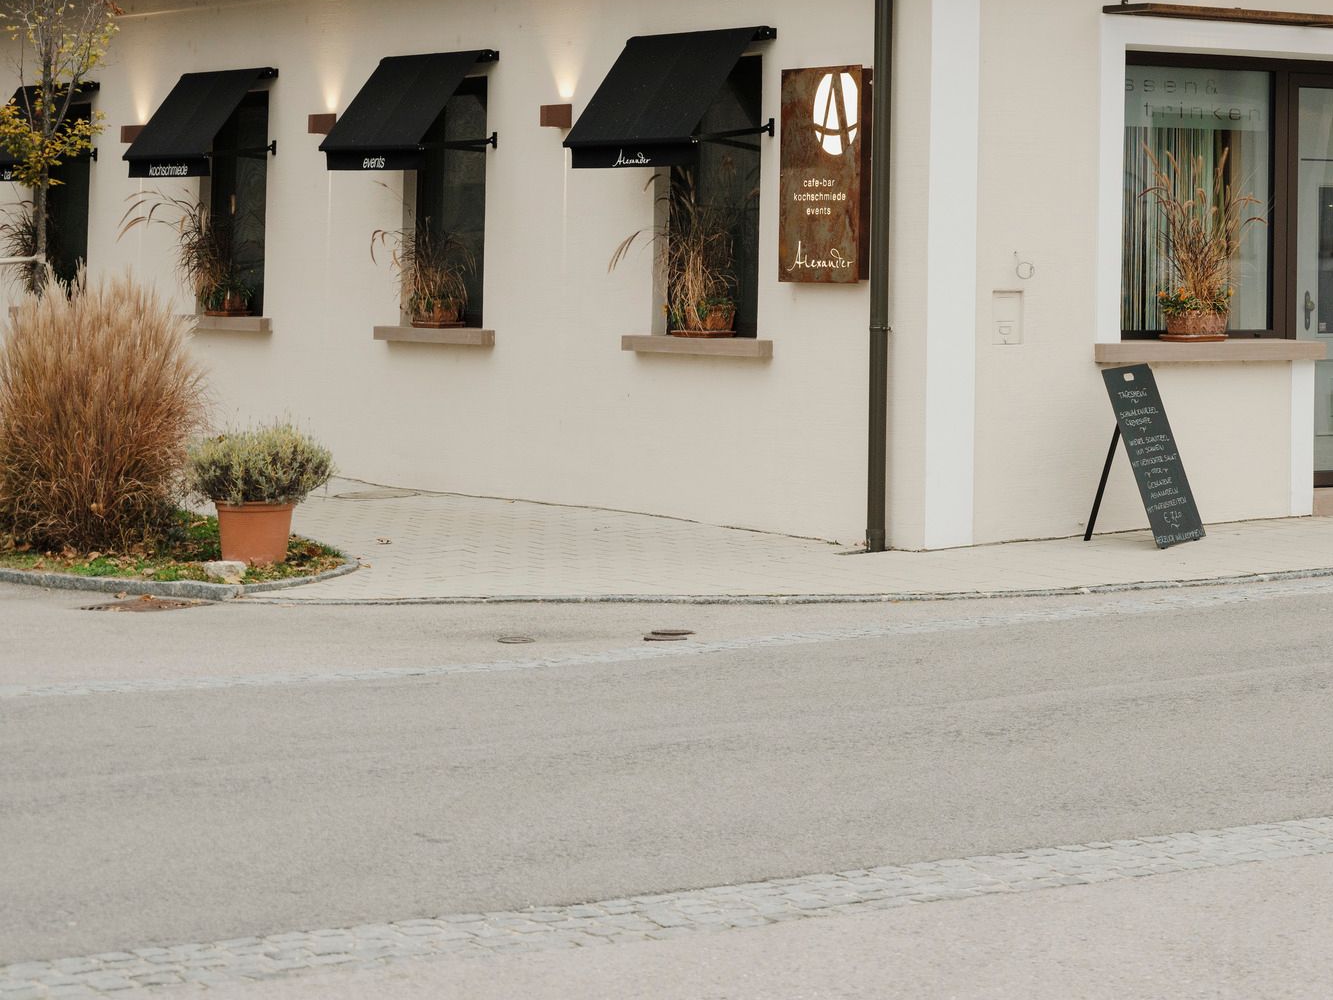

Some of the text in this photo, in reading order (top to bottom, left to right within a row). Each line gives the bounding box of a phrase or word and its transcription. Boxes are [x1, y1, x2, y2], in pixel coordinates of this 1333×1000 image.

[362, 156, 386, 169] events
[612, 148, 651, 167] Alexander
[148, 163, 188, 176] kochschmiede
[803, 178, 835, 188] cafe-bar
[793, 192, 847, 202] kochschmiede
[806, 207, 832, 216] events
[786, 240, 856, 272] Alexander
